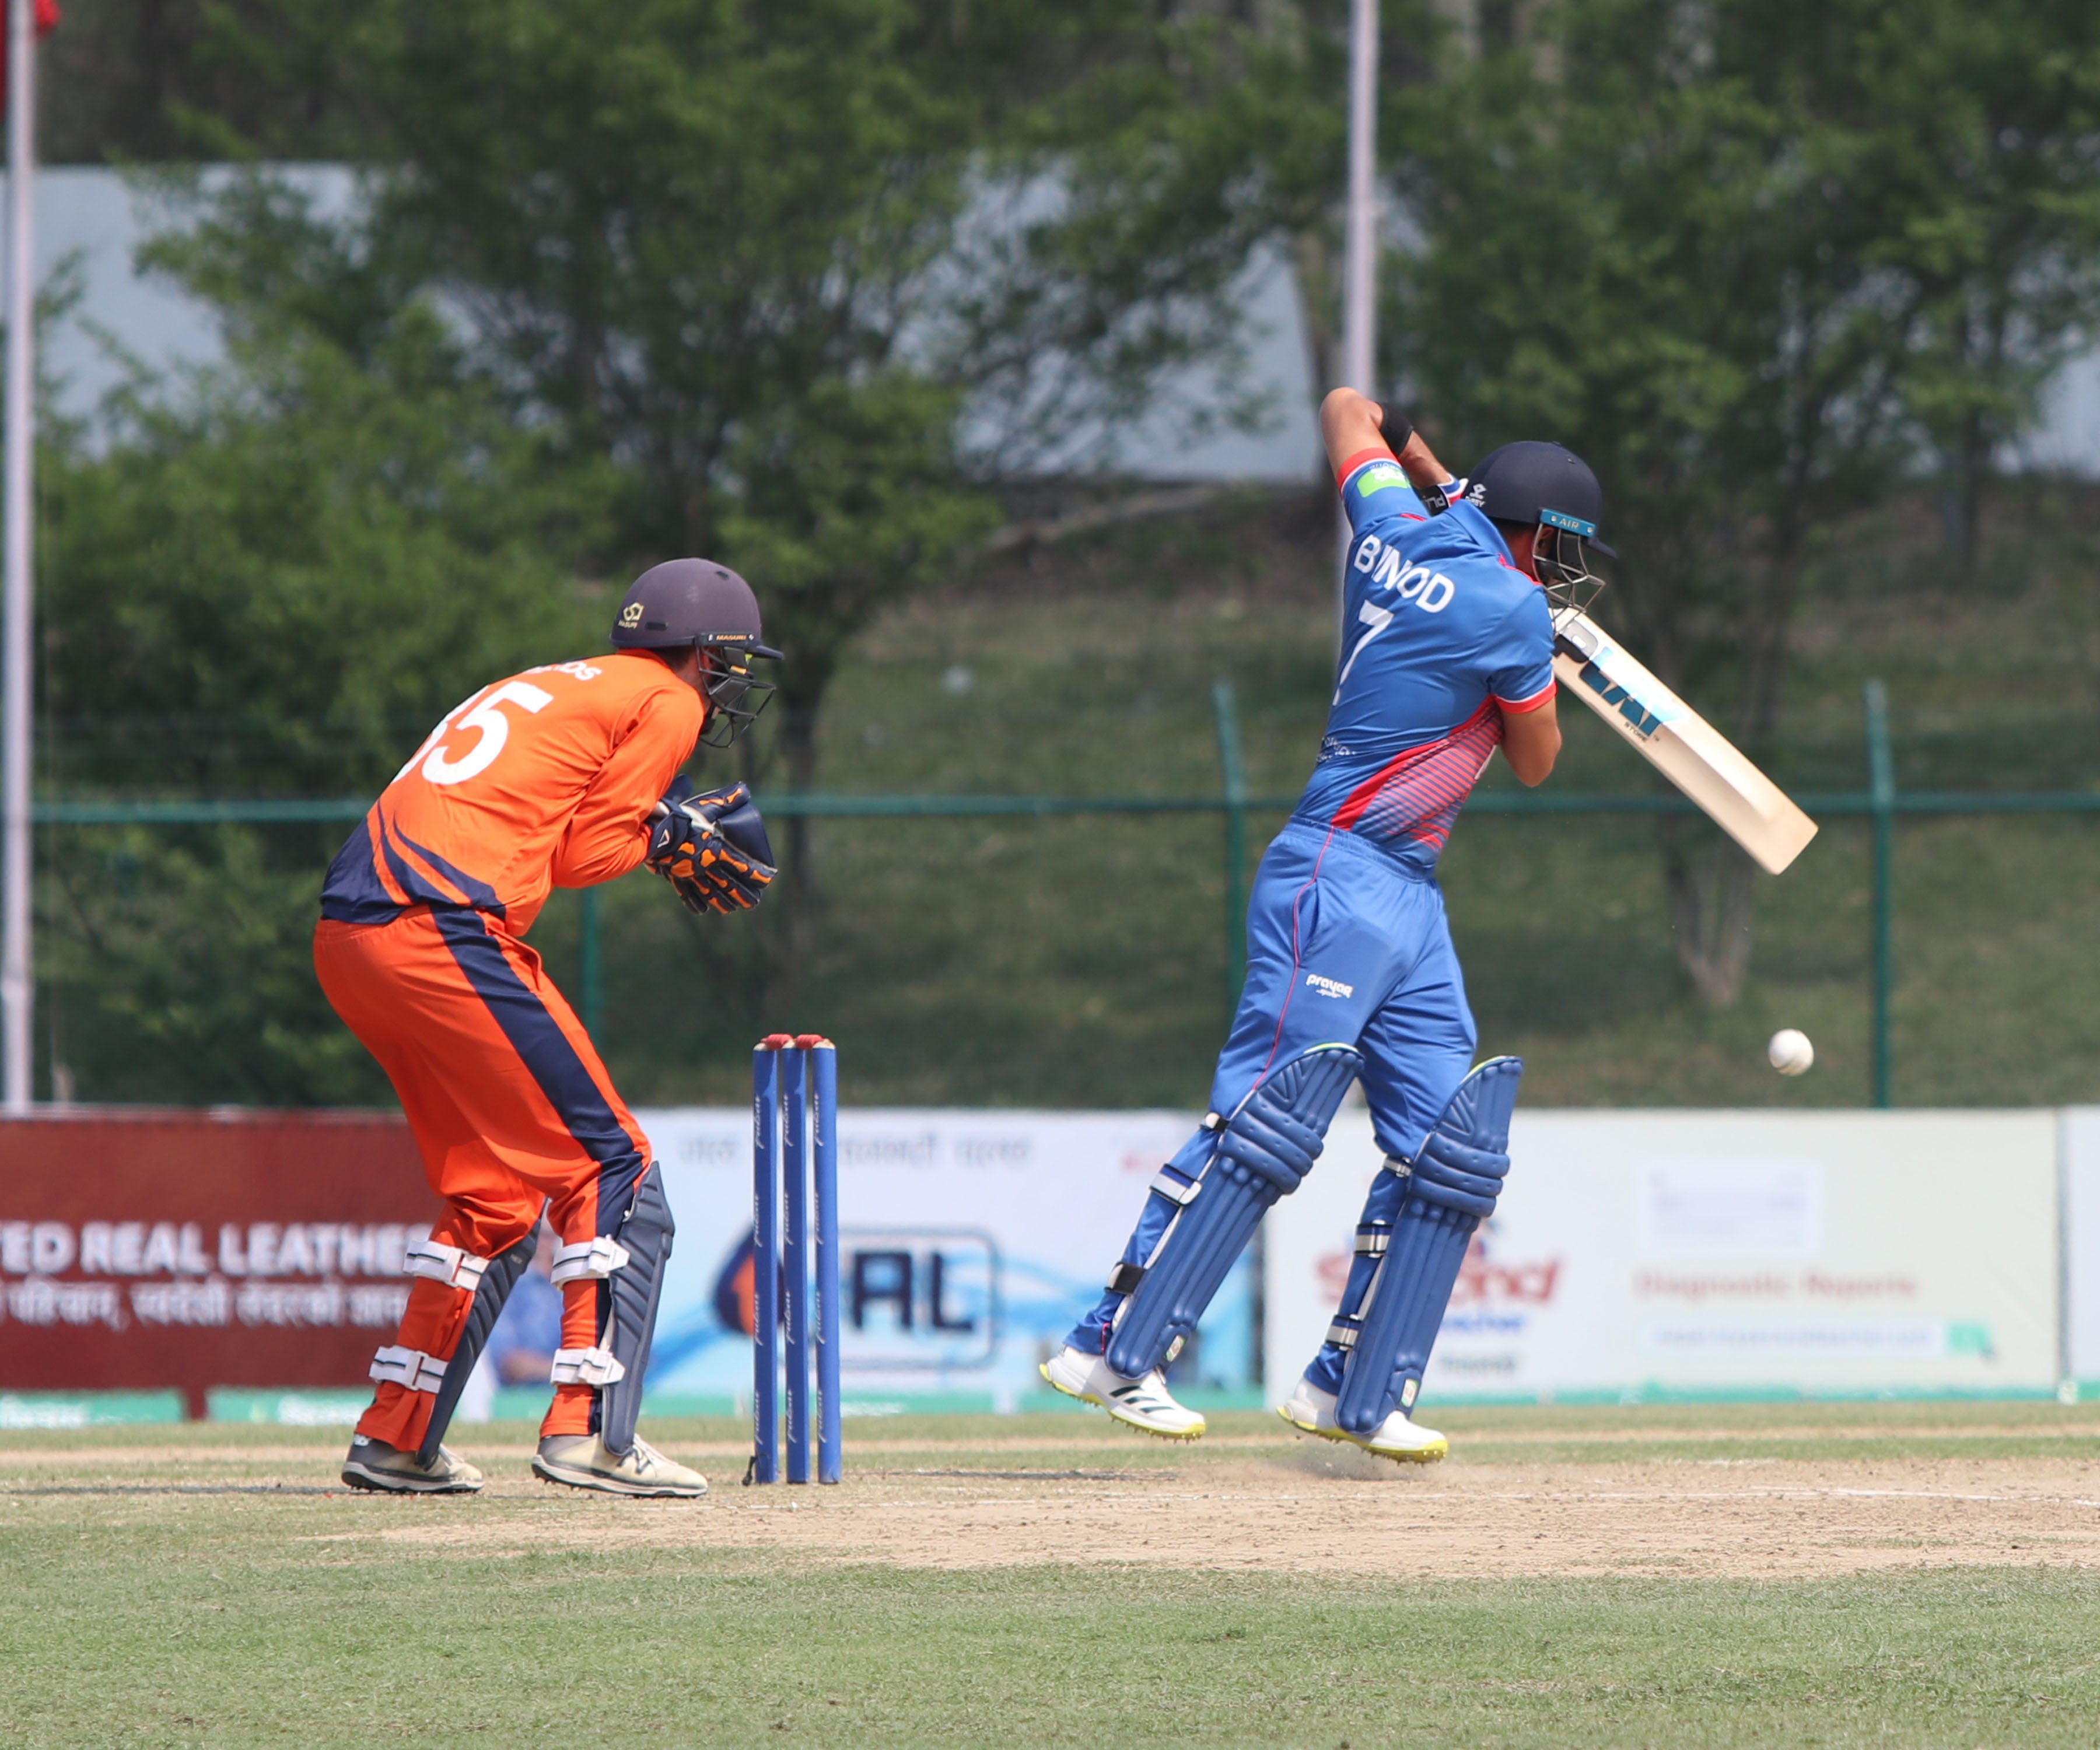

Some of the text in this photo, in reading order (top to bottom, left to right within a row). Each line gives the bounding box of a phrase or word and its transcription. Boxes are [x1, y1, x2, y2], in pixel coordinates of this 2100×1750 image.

[1559, 517, 1580, 529] AIR
[1353, 534, 1455, 613] BINOD
[1332, 599, 1394, 706] 7
[0, 1222, 76, 1274] ED
[80, 1222, 213, 1275] REAL
